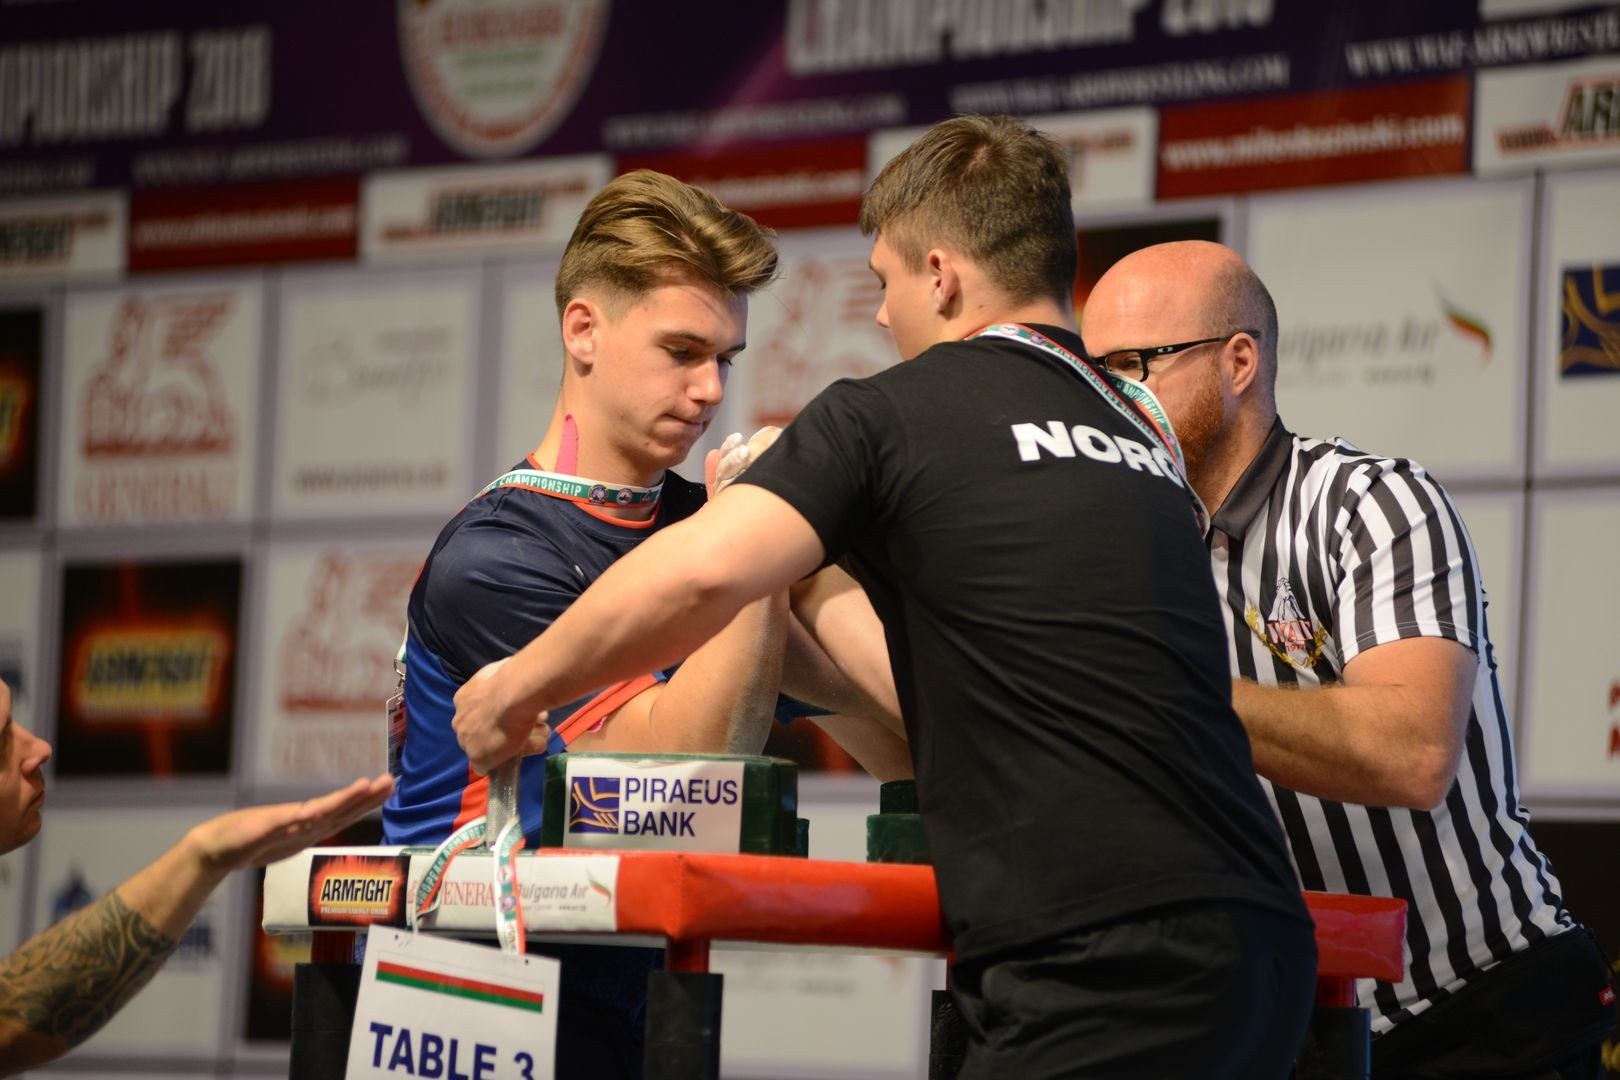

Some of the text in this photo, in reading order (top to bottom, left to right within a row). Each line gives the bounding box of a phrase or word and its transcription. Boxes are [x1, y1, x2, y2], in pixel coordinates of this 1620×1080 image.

[499, 474, 582, 497] CHAMPIONSHIP
[624, 777, 739, 806] PIRAEUS
[623, 810, 697, 838] BANK
[321, 878, 393, 903] ARMFIGHT
[439, 880, 495, 907] ENERA
[517, 882, 568, 904] ulgaria
[369, 1021, 535, 1080] TABLE 3
